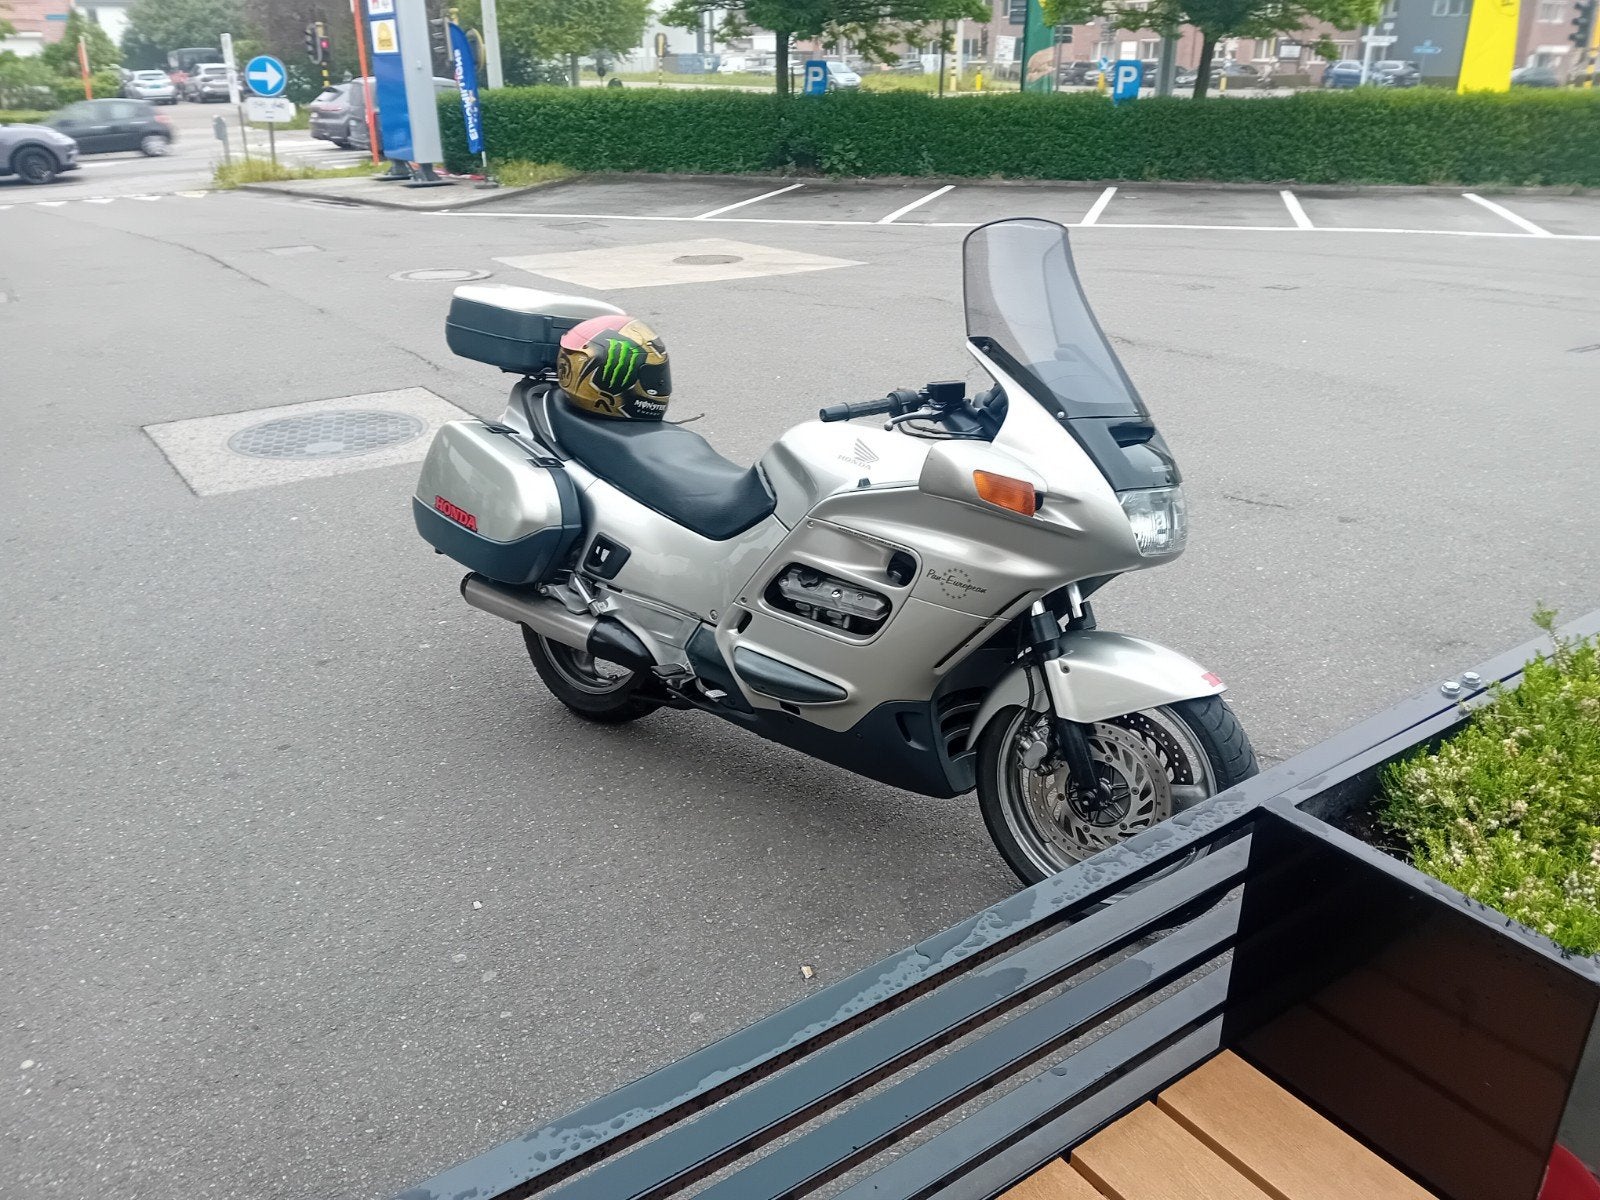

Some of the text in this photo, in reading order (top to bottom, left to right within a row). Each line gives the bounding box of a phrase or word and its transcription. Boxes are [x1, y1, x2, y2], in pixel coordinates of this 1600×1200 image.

[806, 66, 824, 92] P
[1116, 65, 1138, 94] P
[837, 454, 872, 471] HONDA
[434, 495, 478, 533] HONDA
[926, 568, 988, 594] Pan-European
